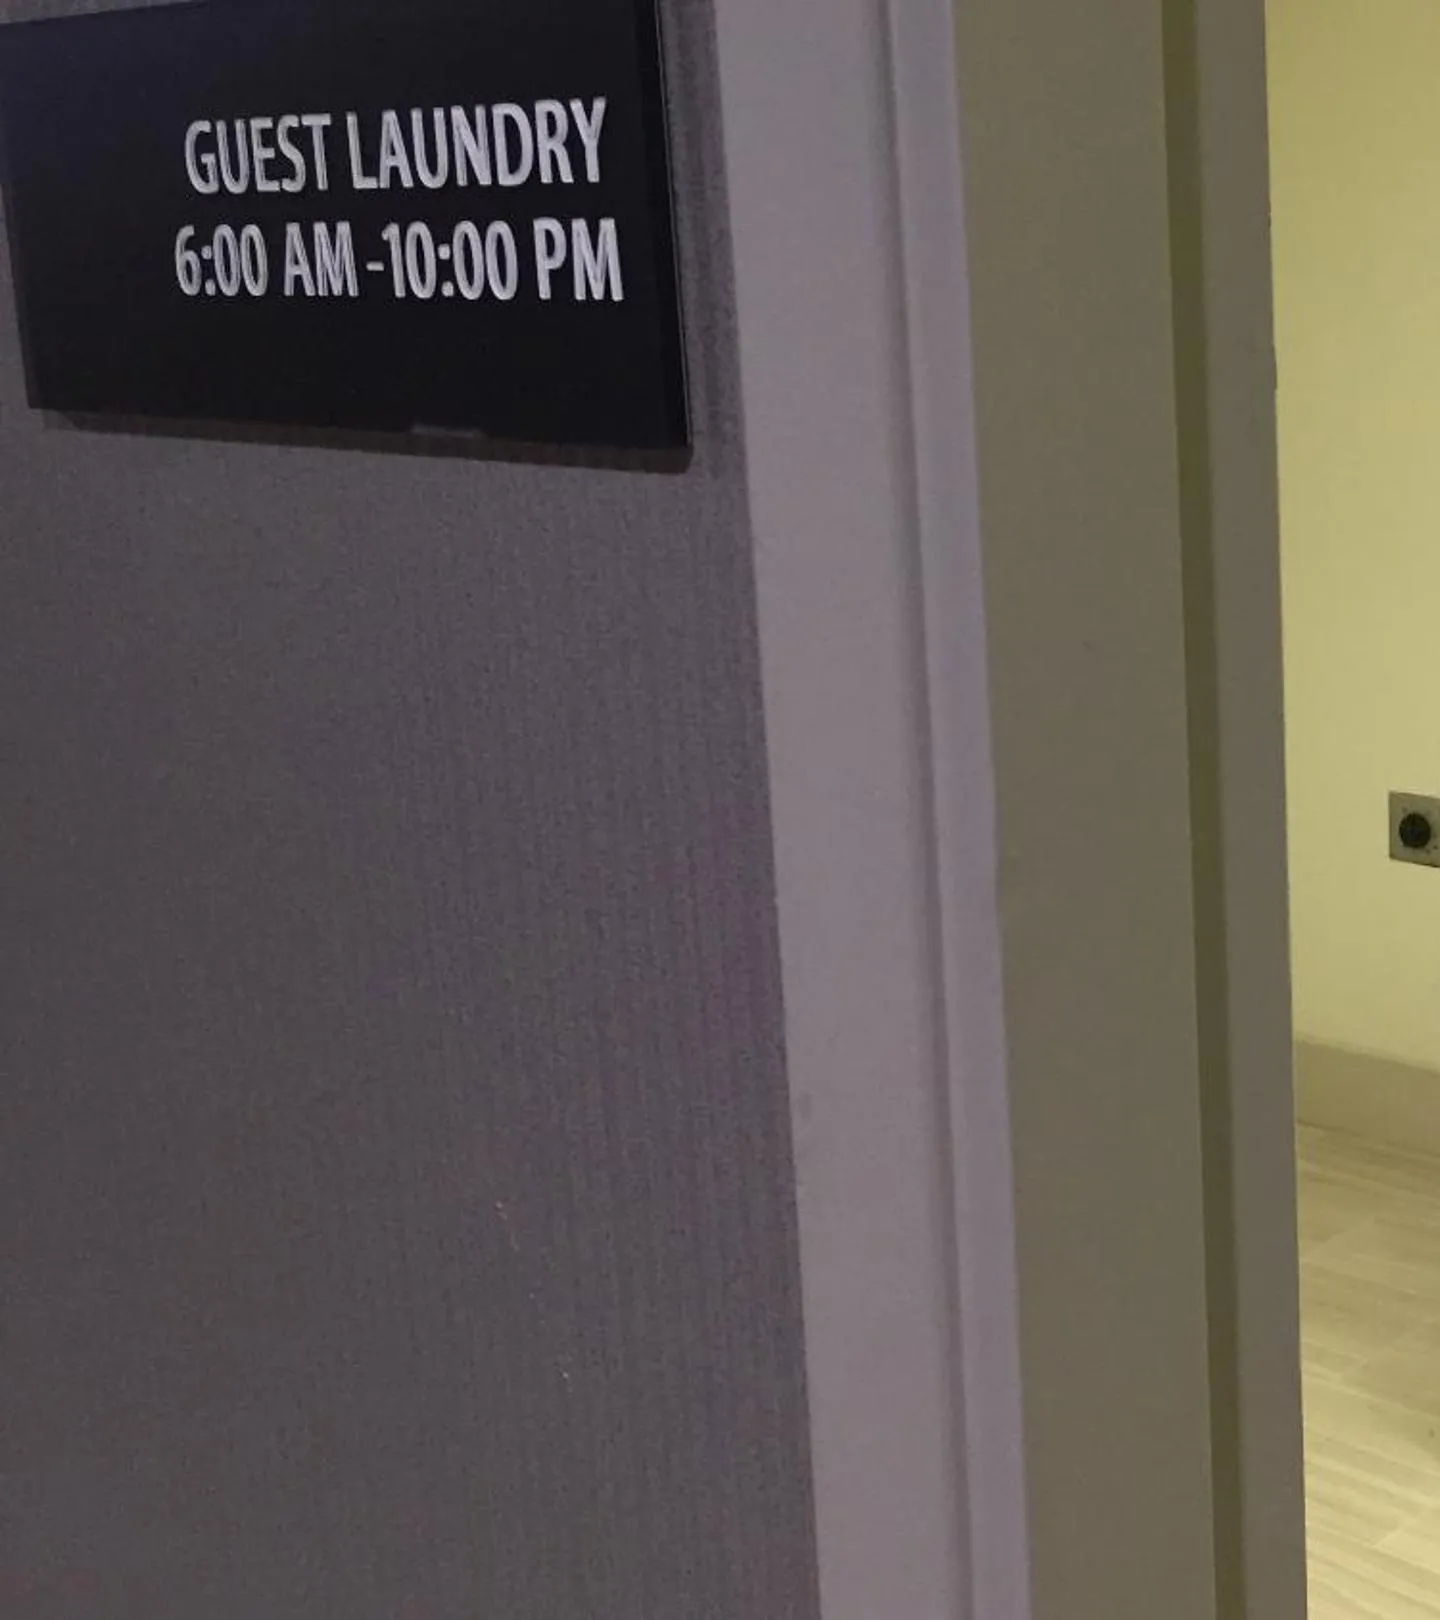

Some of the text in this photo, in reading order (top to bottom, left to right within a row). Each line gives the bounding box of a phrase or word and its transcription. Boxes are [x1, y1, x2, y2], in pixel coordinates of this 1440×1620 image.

[185, 97, 606, 195] GUEST LAUNDRY
[175, 224, 268, 296] 6:00
[284, 221, 359, 297] AM
[533, 217, 624, 302] PM
